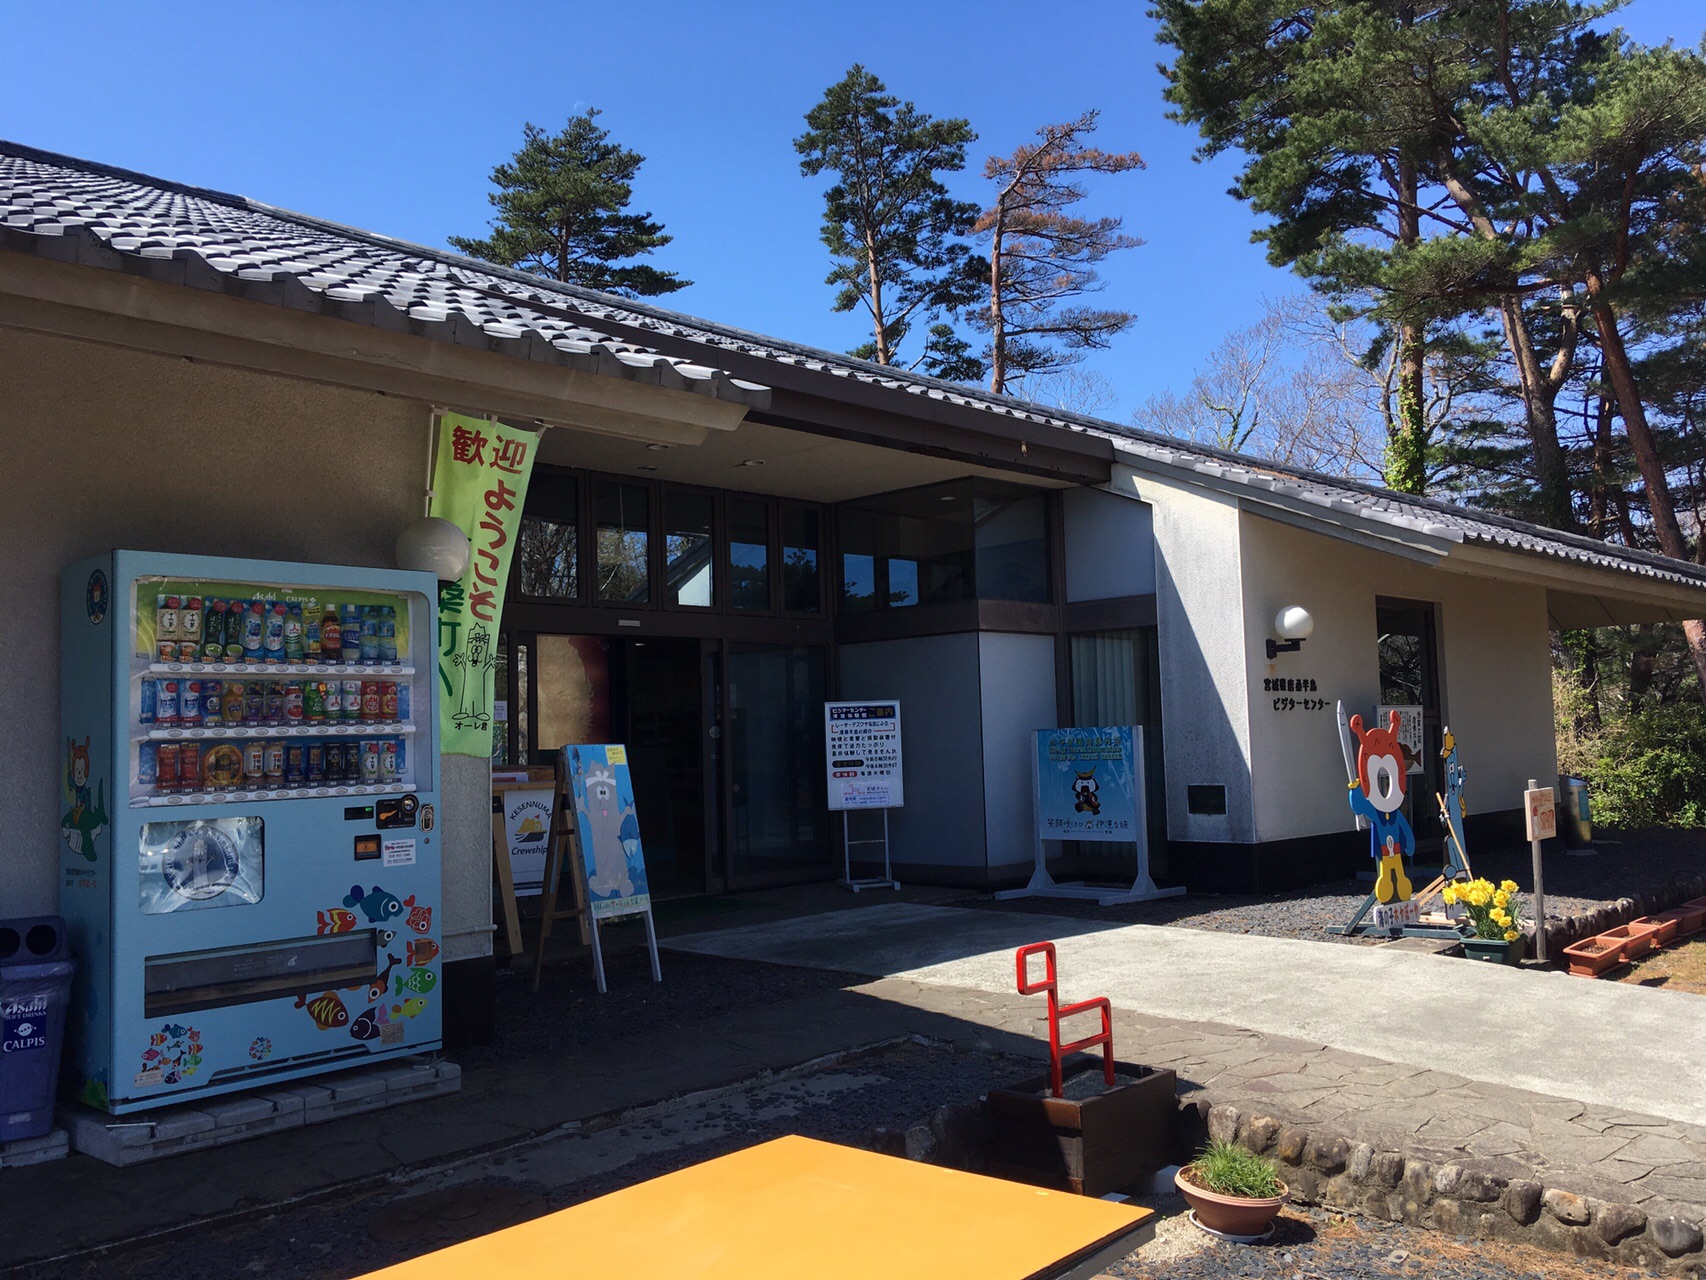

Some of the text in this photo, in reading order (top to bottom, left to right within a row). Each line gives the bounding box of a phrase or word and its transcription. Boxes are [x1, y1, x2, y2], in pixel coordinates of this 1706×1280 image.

[451, 425, 528, 475] 歓迎
[468, 478, 517, 622] ようこそ
[1272, 697, 1331, 711] ビジターセンター
[454, 721, 488, 731] オーレ君
[509, 801, 552, 821] KESENNUMA
[511, 846, 548, 856] Crewship
[5, 997, 48, 1014] Asahi
[3, 1036, 46, 1053] CALPIS
